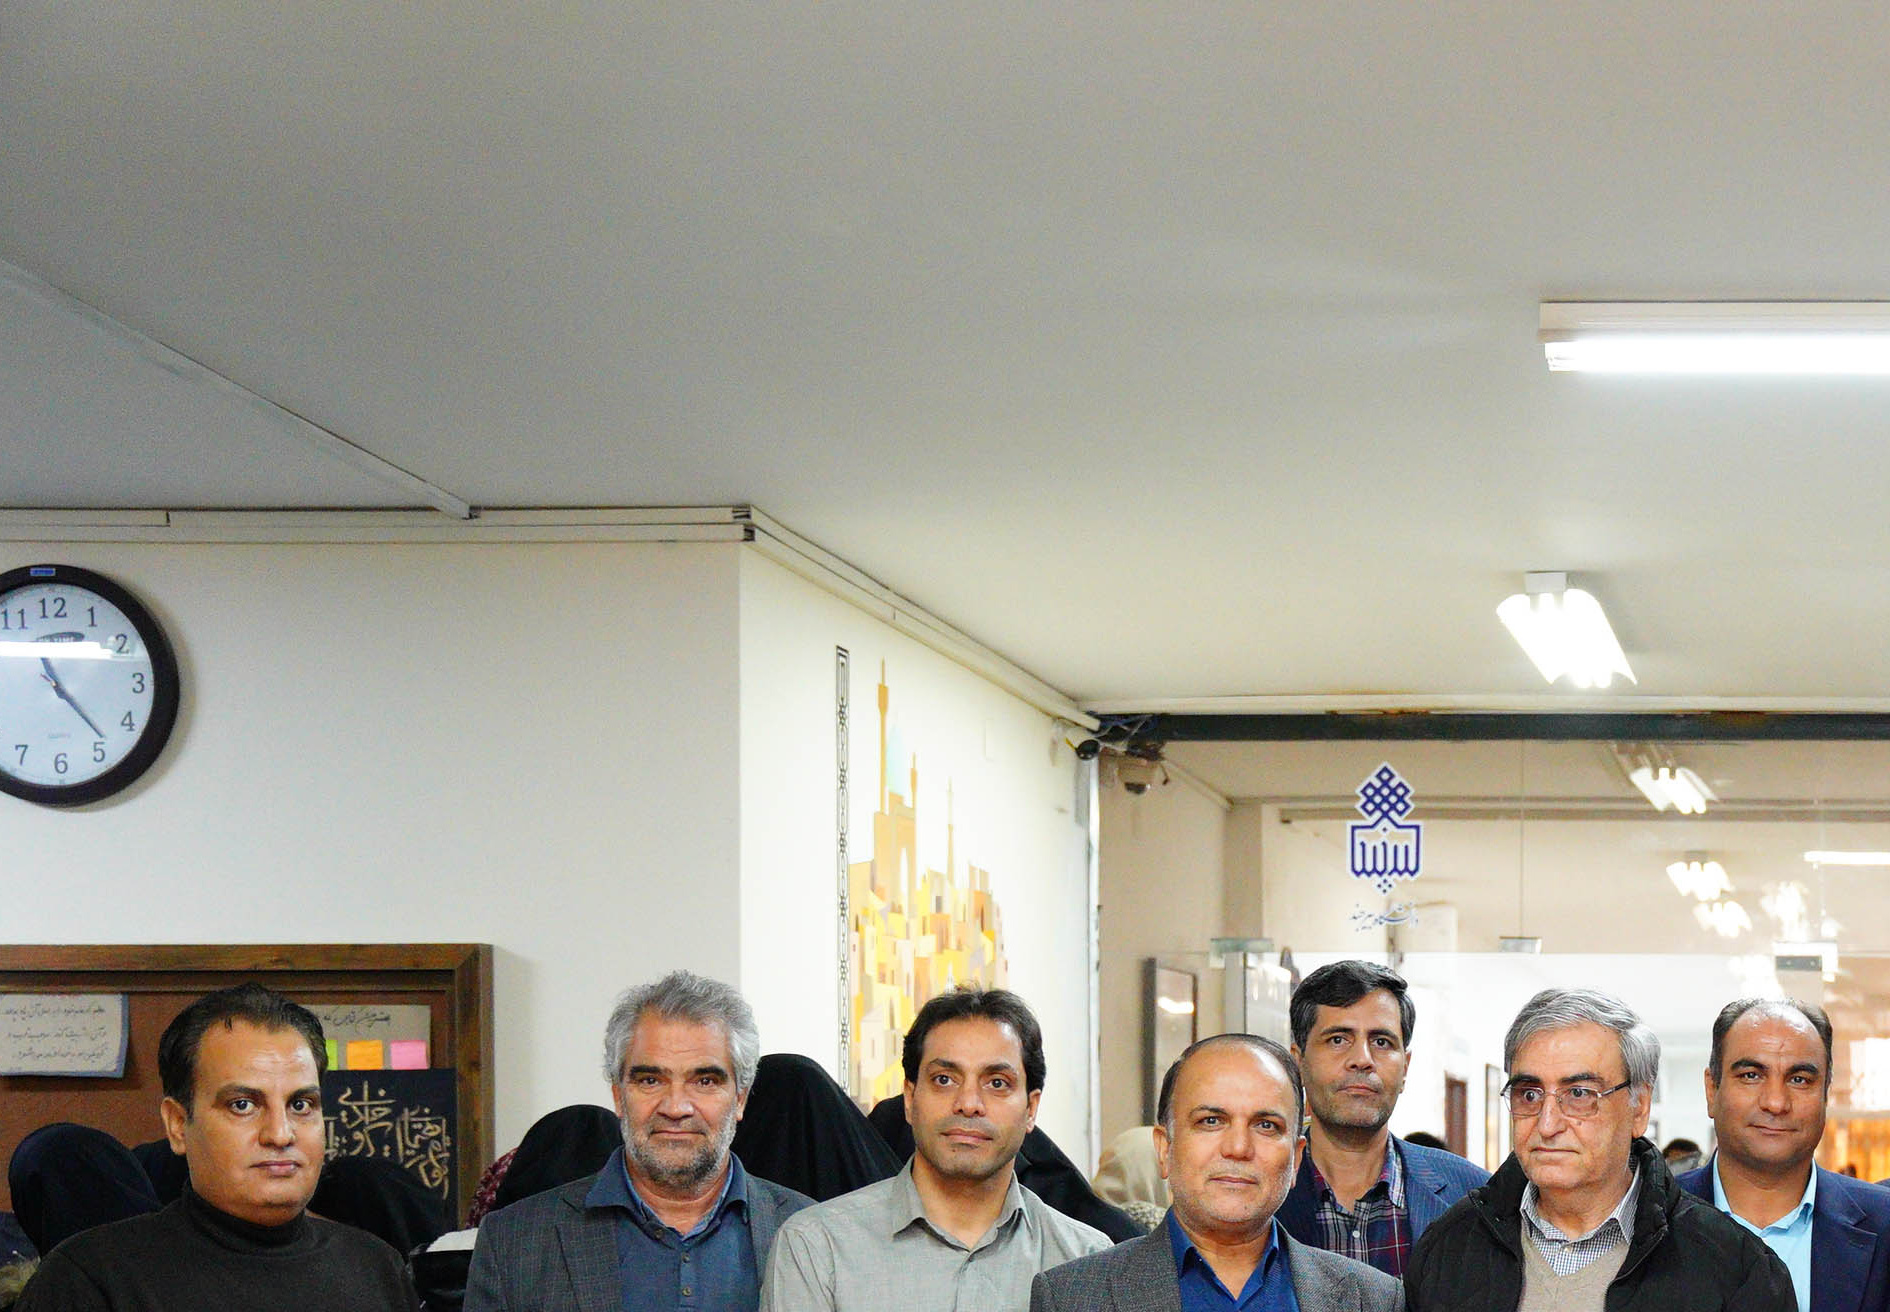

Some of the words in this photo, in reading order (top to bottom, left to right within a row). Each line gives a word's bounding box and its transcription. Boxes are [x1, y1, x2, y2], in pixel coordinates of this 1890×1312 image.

[39, 597, 67, 619] 12
[87, 606, 98, 627] 1
[1, 608, 28, 630] 11
[115, 634, 130, 654] 2
[132, 672, 145, 694] 3
[121, 711, 136, 732] 4
[15, 745, 28, 766] 7
[93, 742, 105, 763] 5
[54, 753, 68, 774] 6
[1373, 902, 1418, 926] دانشگاه
